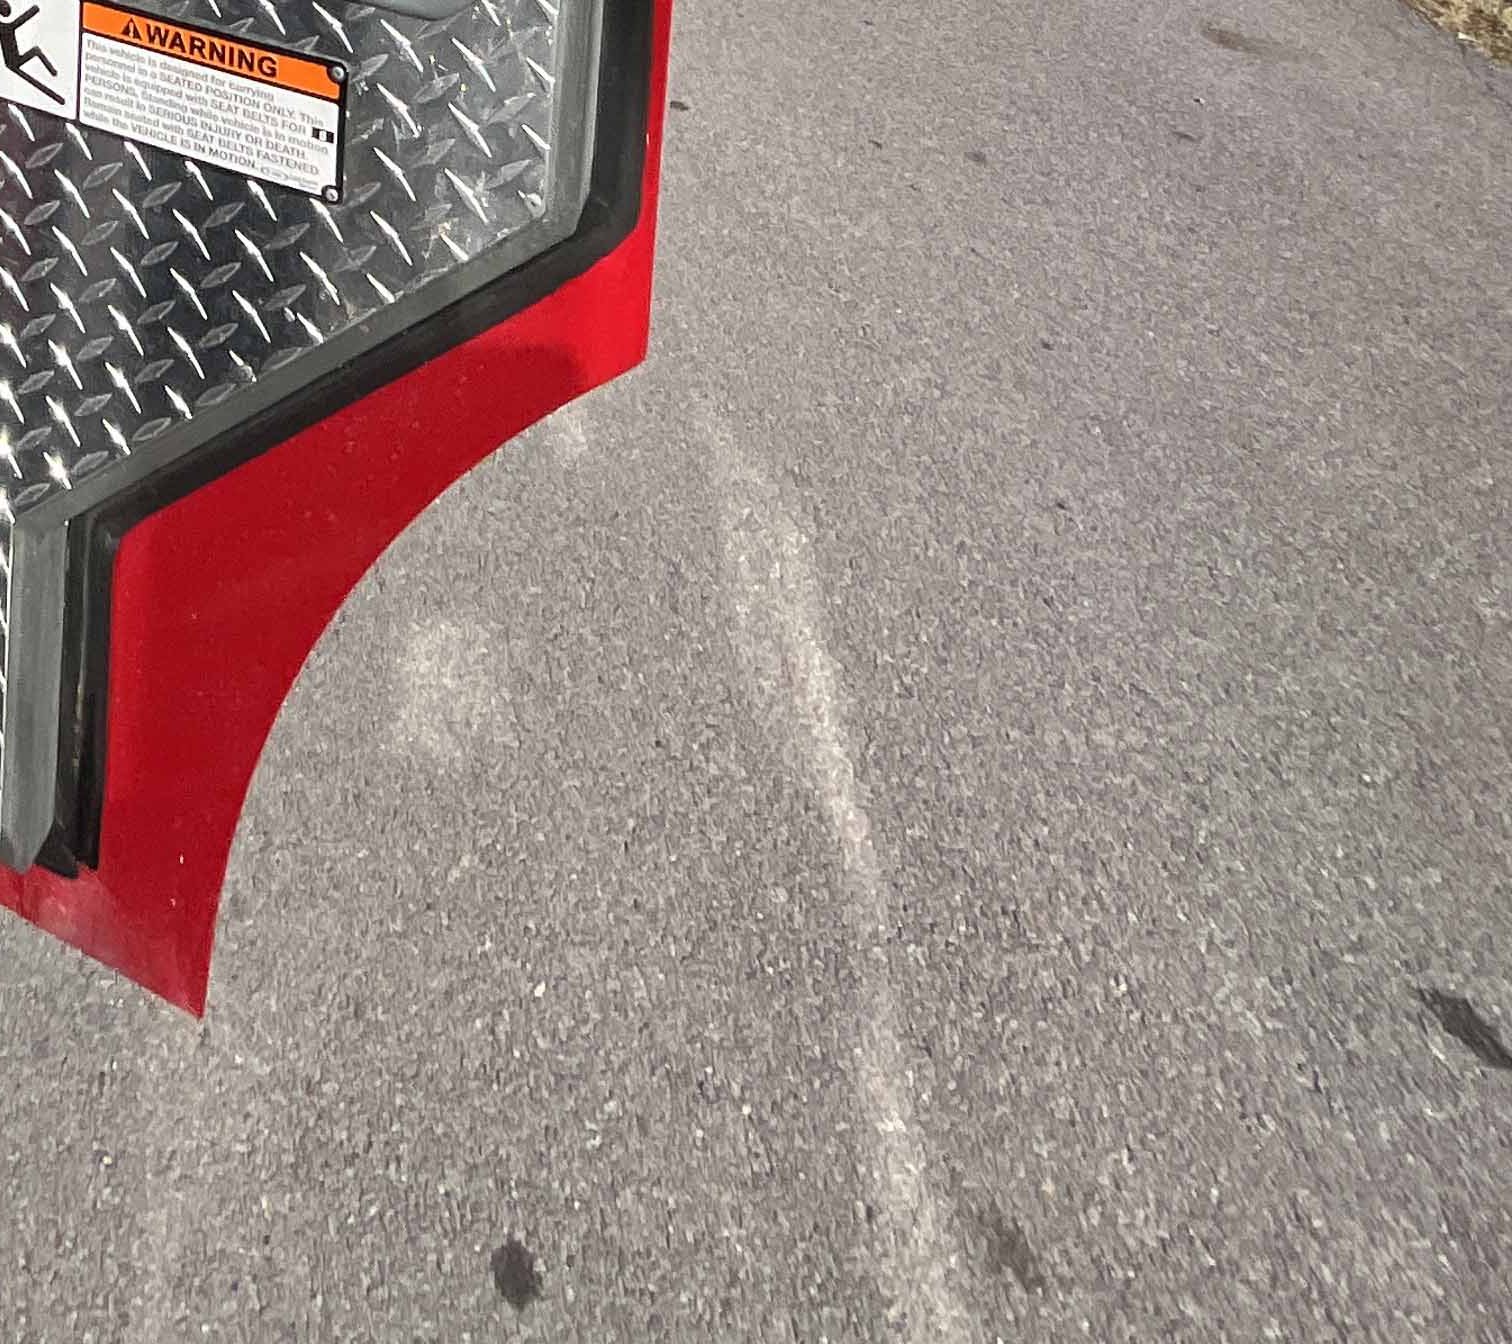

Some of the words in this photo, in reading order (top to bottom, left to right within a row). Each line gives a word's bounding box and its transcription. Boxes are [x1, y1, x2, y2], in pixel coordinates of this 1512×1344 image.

[146, 23, 277, 78] WARNING
[206, 85, 259, 109] POSITION
[210, 98, 239, 116] SEAT
